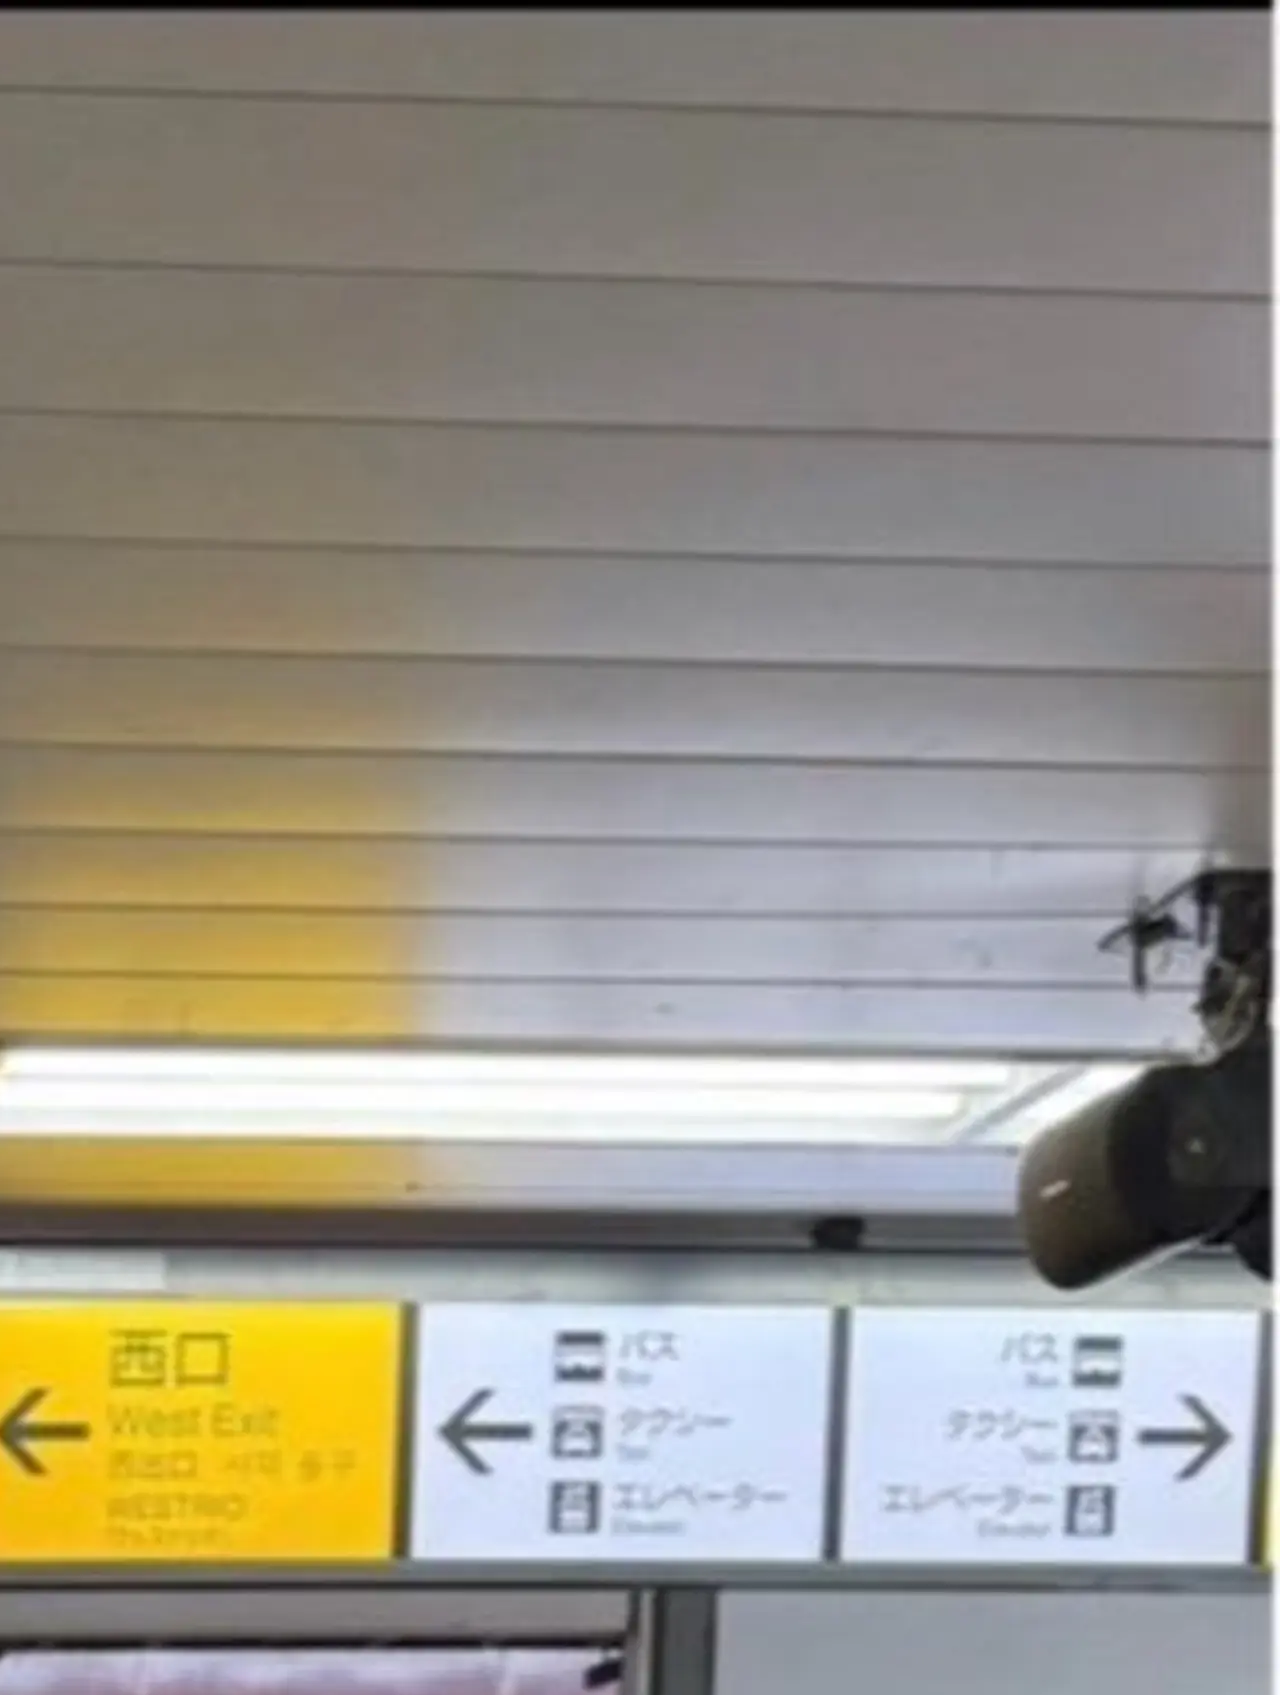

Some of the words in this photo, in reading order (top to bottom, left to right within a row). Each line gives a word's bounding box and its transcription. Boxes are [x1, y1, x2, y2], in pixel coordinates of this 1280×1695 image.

[108, 1329, 231, 1387] 西口
[620, 1331, 680, 1360] バス
[1001, 1334, 1058, 1362] バス
[107, 1403, 200, 1439] West
[210, 1402, 282, 1438] Exit
[620, 1408, 734, 1436] タクシー
[946, 1410, 1059, 1440] タクシー
[613, 1483, 788, 1511] エレベーター
[880, 1484, 1056, 1515] エレベーター
